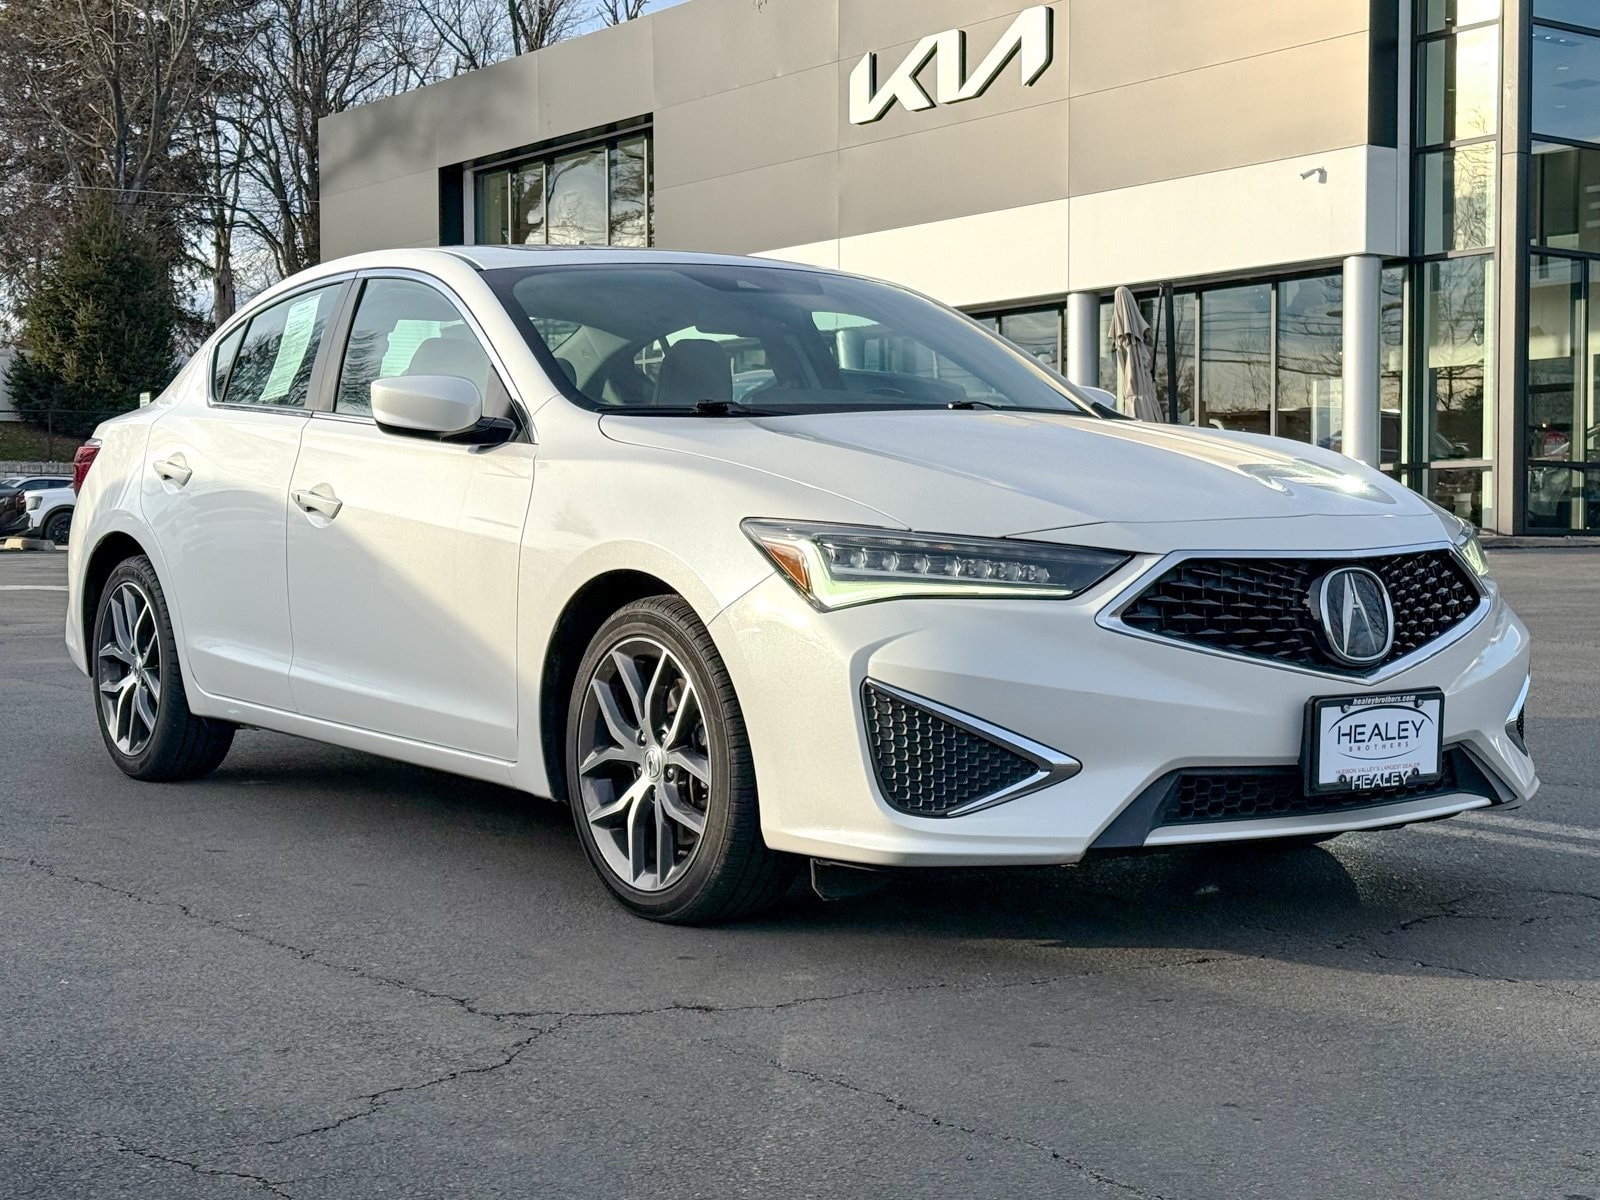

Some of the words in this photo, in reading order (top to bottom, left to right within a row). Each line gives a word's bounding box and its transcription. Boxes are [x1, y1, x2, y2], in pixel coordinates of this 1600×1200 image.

[1352, 695, 1416, 705] healeybrothers.com
[1337, 719, 1425, 745] HEALEY
[1349, 742, 1409, 752] BROTHERS
[1351, 771, 1409, 790] HEALEY
